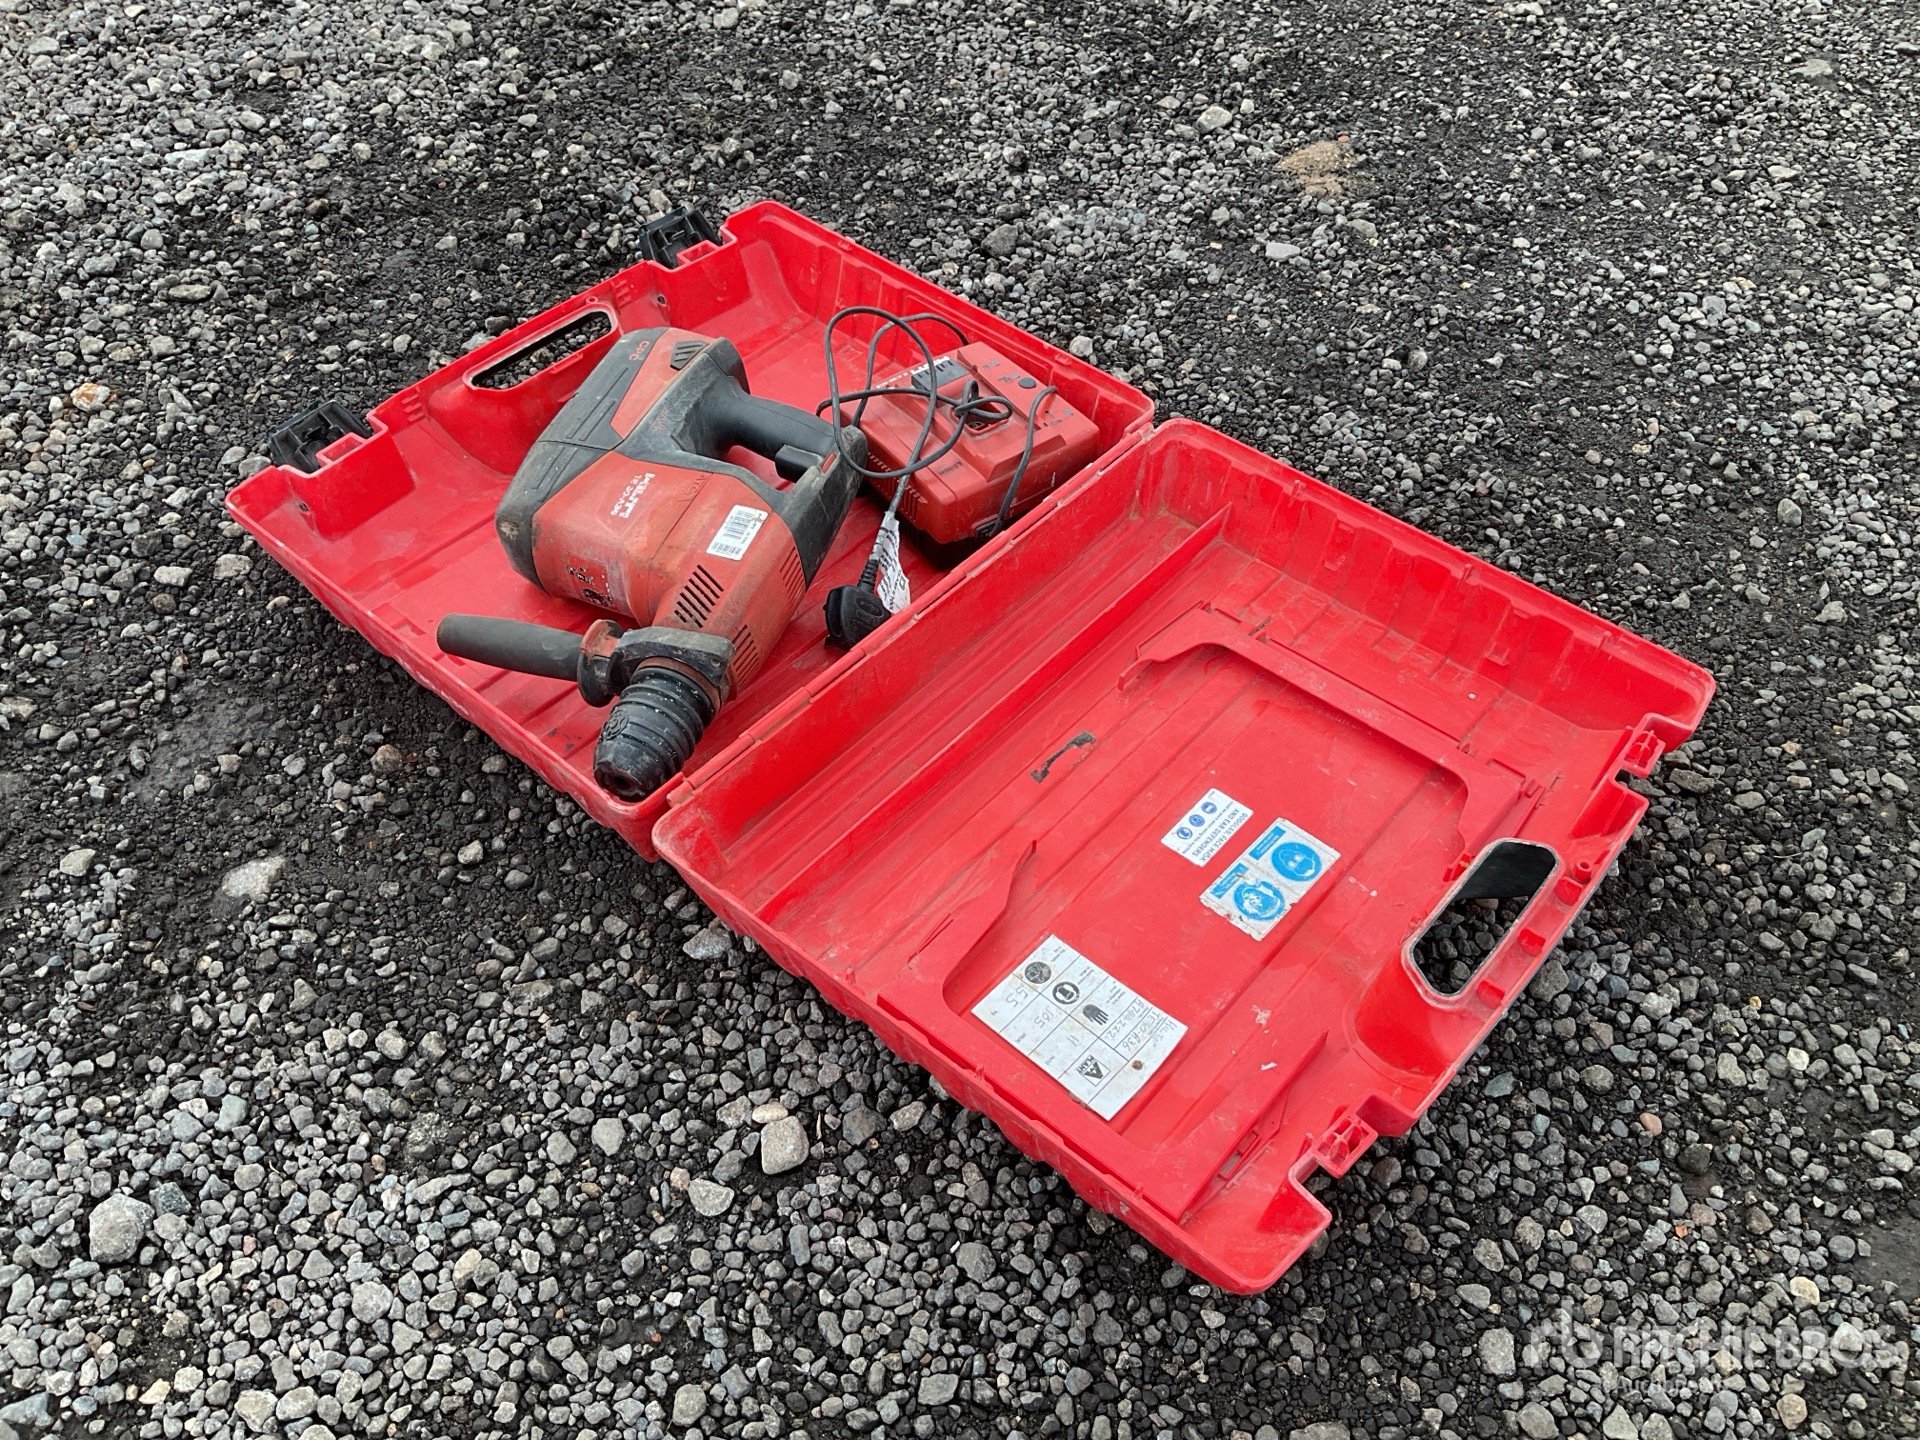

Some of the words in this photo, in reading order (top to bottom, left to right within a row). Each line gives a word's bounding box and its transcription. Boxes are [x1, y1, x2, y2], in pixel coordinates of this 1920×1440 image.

[628, 340, 650, 361] CPC
[1228, 808, 1240, 820] AND
[1218, 818, 1231, 830] EAR
[1192, 828, 1221, 857] DEFENDERS
[1213, 834, 1227, 849] FACE
[1200, 846, 1216, 862] MASK
[1075, 1055, 1095, 1075] PLANT
